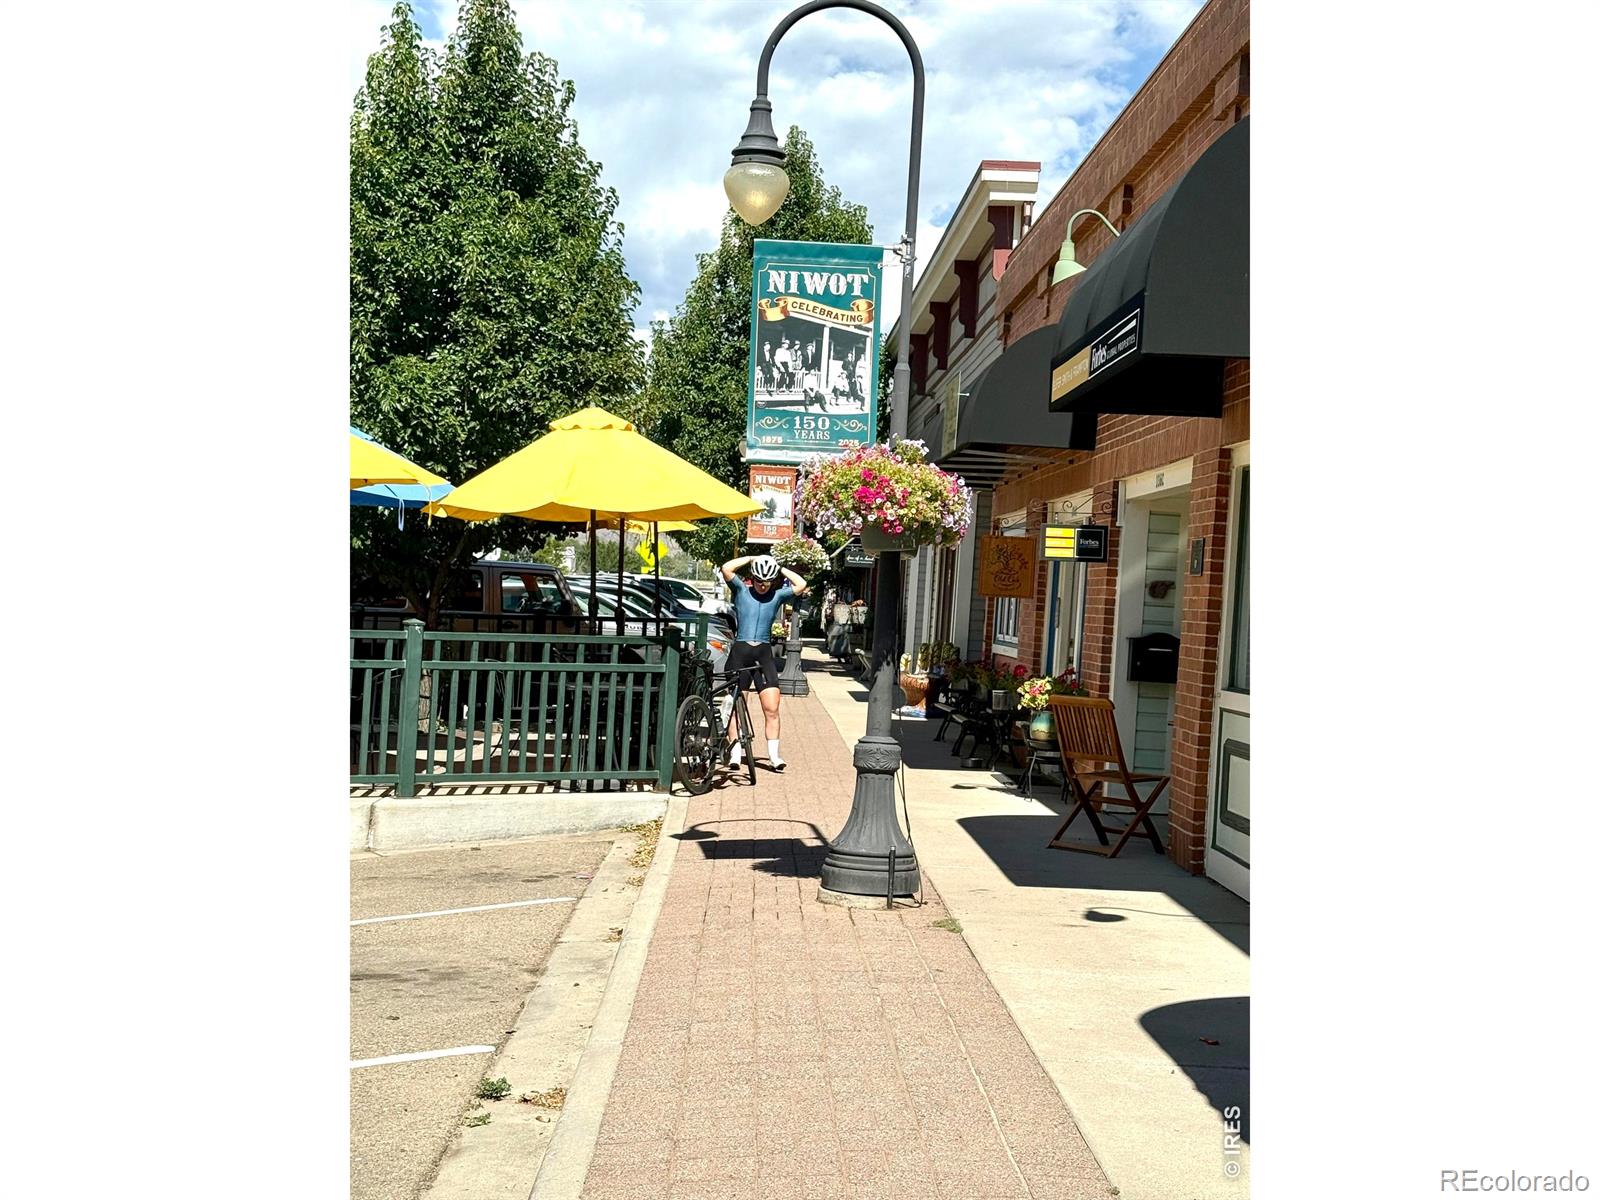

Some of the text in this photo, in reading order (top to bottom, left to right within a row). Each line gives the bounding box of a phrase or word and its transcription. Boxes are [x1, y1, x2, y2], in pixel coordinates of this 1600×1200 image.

[767, 270, 868, 296] NIWOT
[791, 301, 863, 323] CELEBRATING
[793, 416, 830, 430] 150
[794, 430, 830, 440] YEARS
[755, 475, 791, 485] NIWOT
